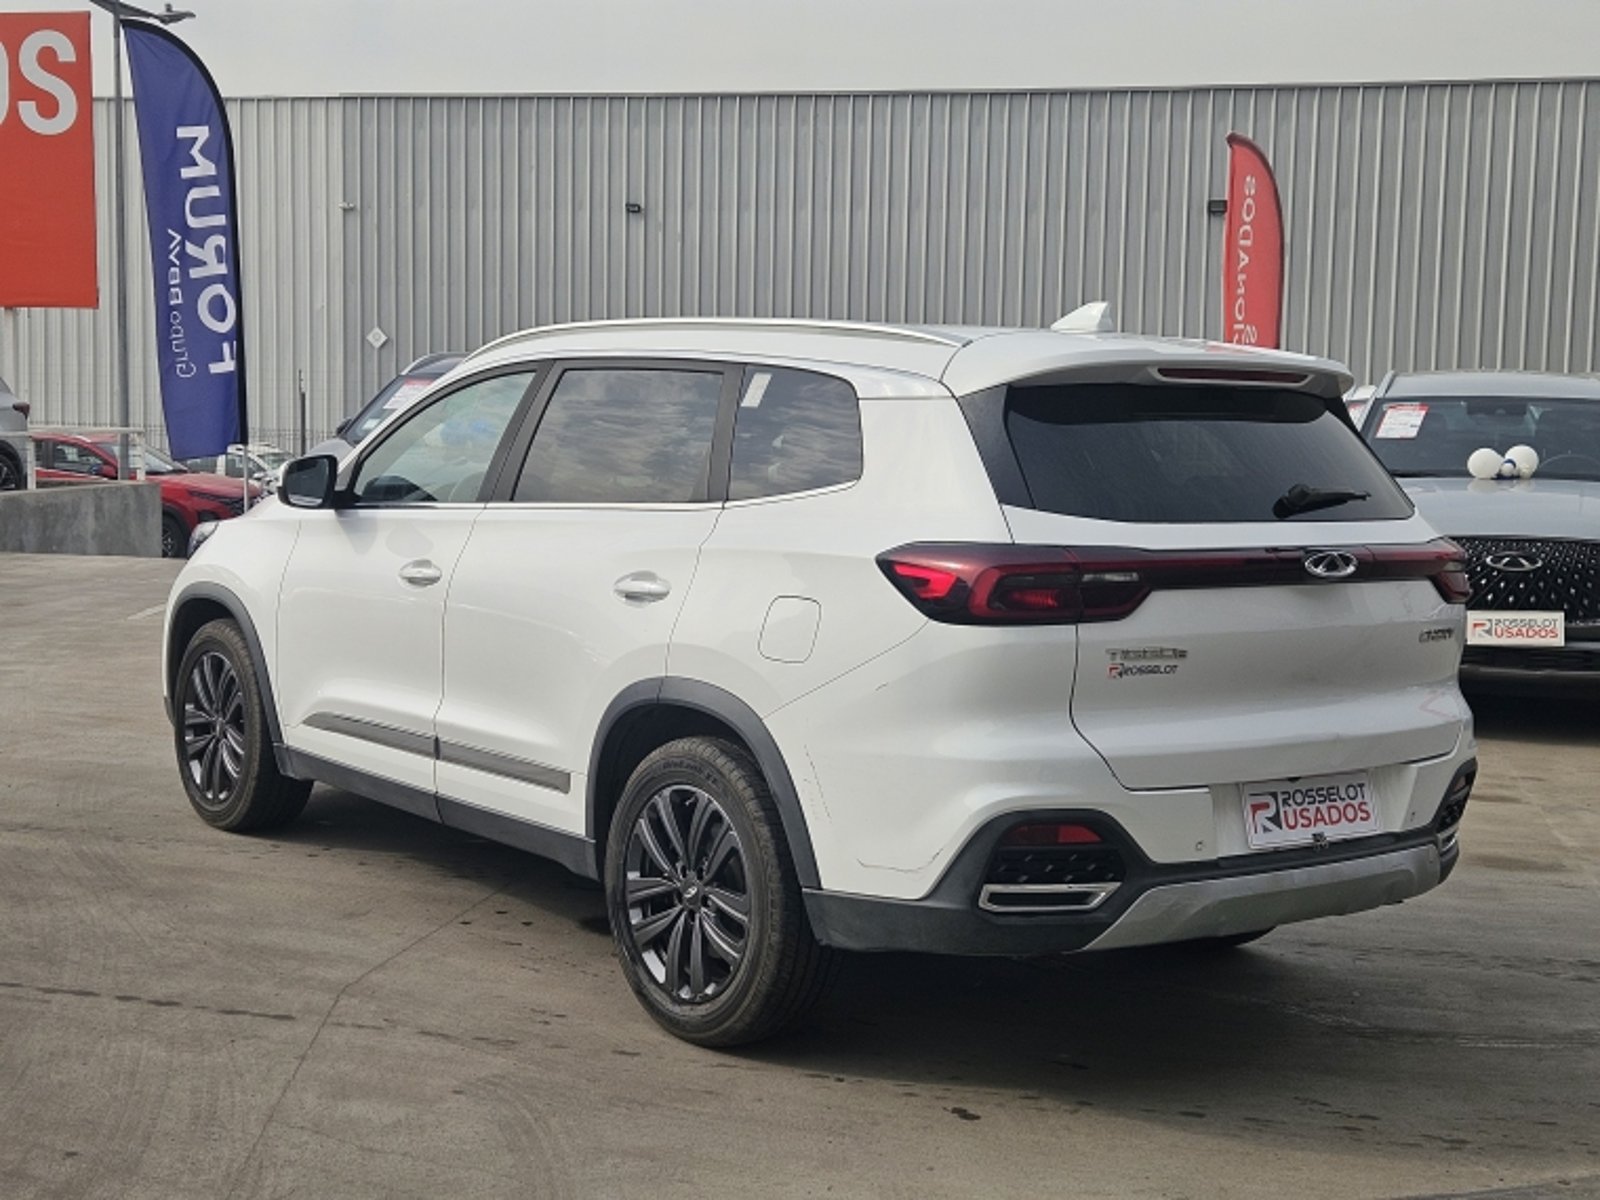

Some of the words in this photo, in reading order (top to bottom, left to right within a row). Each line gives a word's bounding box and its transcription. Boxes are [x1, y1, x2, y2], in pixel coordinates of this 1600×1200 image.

[0, 29, 77, 135] S
[1494, 618, 1559, 628] ROSSELOT
[1494, 627, 1559, 639] USADOS
[1280, 783, 1366, 807] ROSSELOT
[1283, 801, 1372, 830] USADOS
